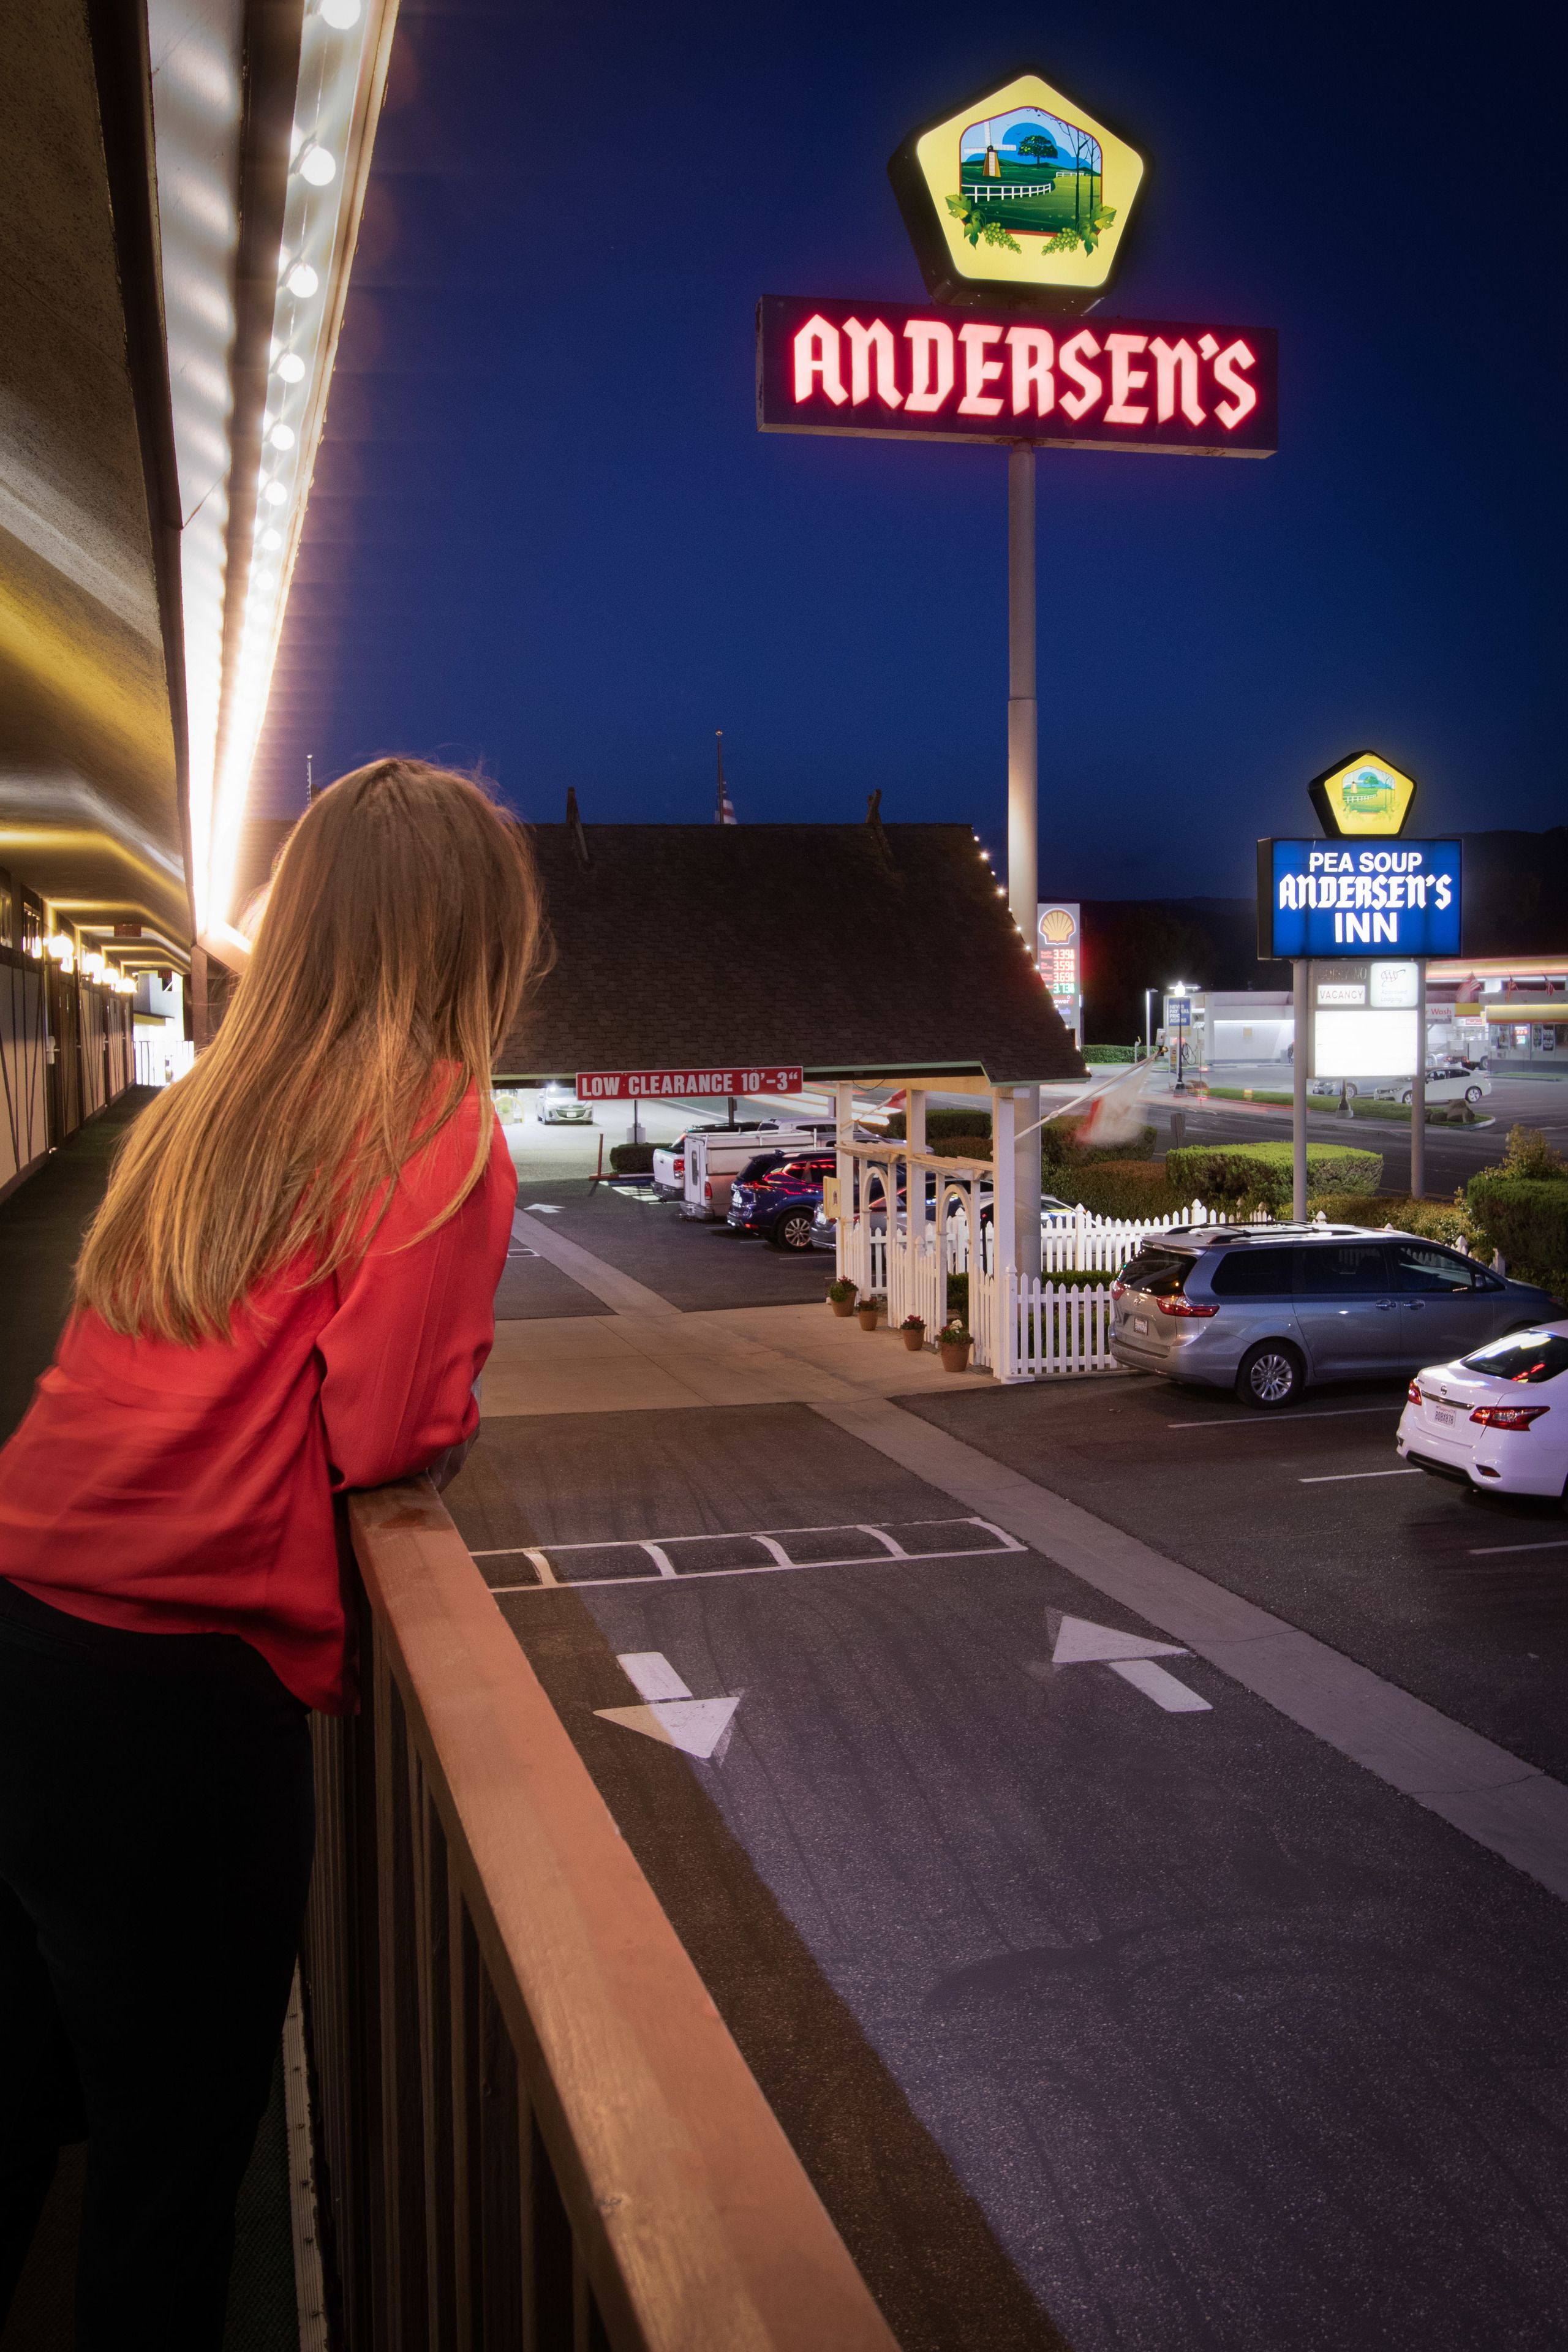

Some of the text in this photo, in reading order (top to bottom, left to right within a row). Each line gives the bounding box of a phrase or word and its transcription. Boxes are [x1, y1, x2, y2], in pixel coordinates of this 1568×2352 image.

[793, 313, 1257, 429] ANDERSEN'S
[1310, 852, 1422, 872] PEA SOUP
[1279, 873, 1452, 910] ANDERSEN'S
[1335, 912, 1398, 943] INN
[1320, 990, 1363, 999] VACANCY
[582, 1077, 620, 1096] LOW
[628, 1073, 733, 1095] CLEARANCE
